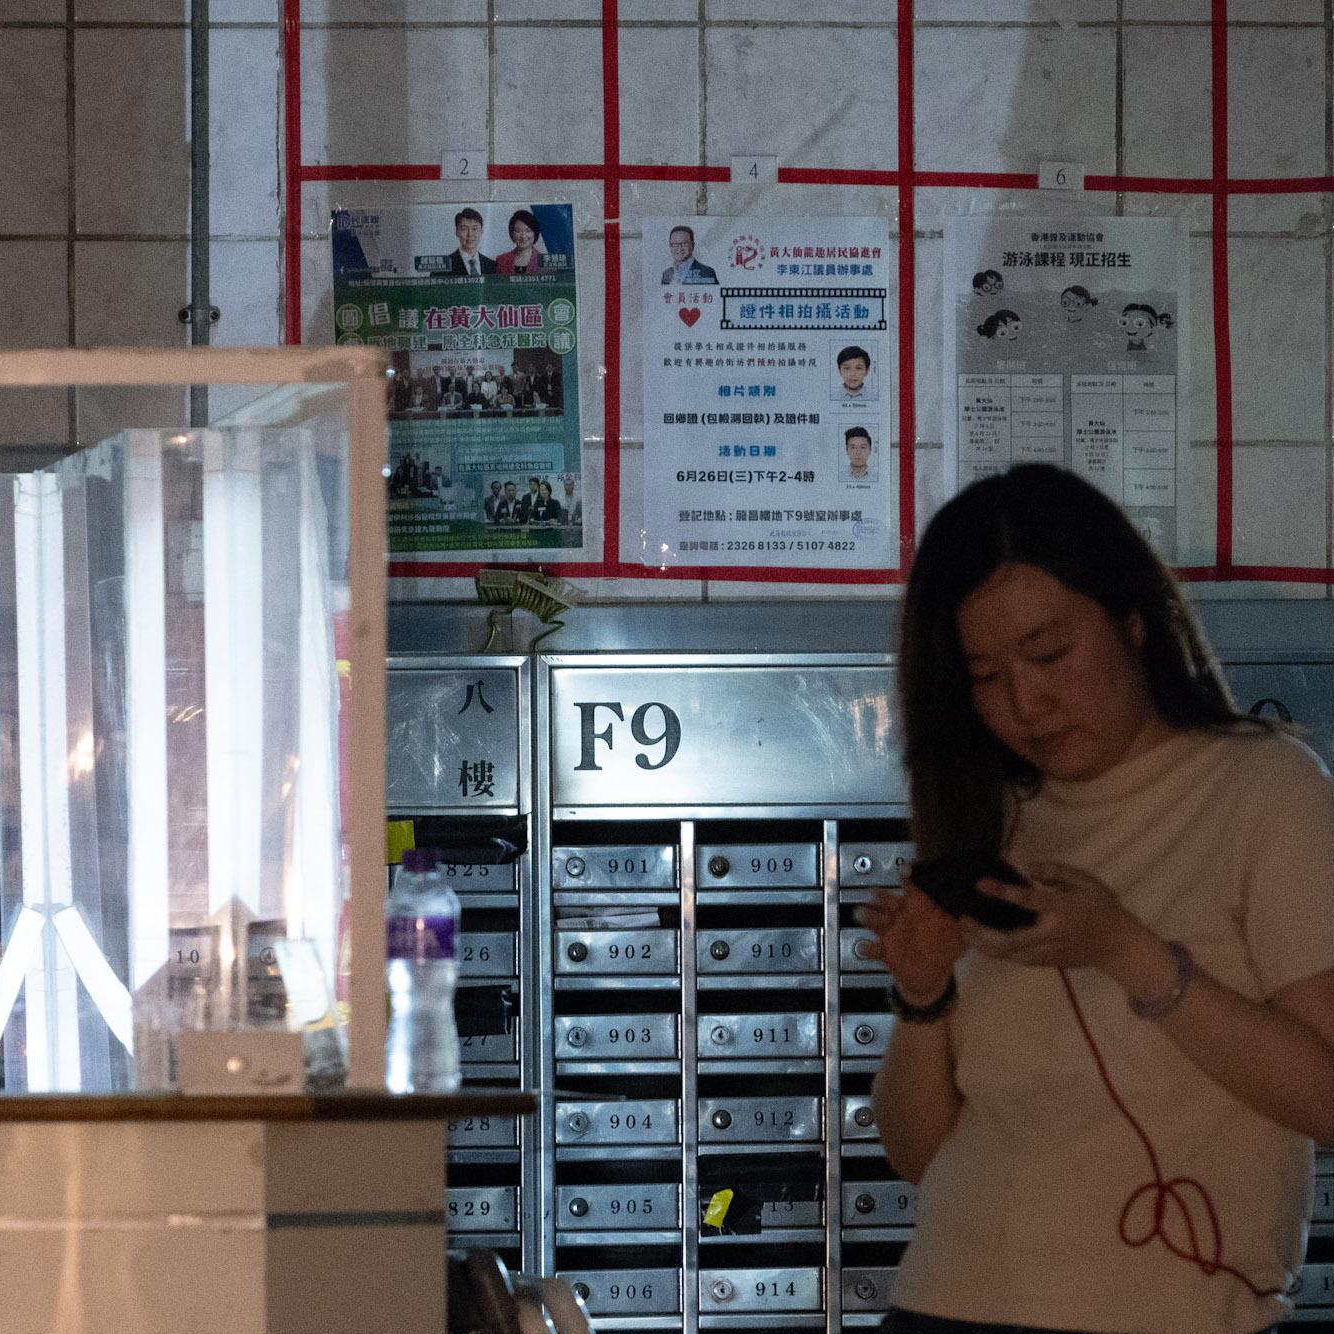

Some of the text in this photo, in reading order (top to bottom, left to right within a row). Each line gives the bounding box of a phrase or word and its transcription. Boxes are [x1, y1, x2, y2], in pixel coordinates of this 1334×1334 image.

[459, 158, 469, 175] 2
[748, 163, 759, 179] 4
[1056, 169, 1066, 185] 6
[1002, 251, 1132, 267] 游泳課程 現正招生
[739, 302, 870, 319] 證件相拍攝活動
[758, 541, 786, 551] 8133
[828, 541, 856, 551] 4822
[457, 679, 495, 798] 八樓
[573, 702, 682, 771] F9
[607, 857, 649, 876] 901
[750, 857, 794, 874] 909
[463, 946, 490, 961] 26
[608, 943, 652, 960] 902
[750, 942, 793, 959] 910
[608, 1027, 652, 1044] 903
[752, 1027, 791, 1044] 911
[608, 1114, 652, 1130] 904
[754, 1111, 794, 1126] 912
[449, 1201, 491, 1216] 829
[609, 1198, 654, 1215] 905
[609, 1283, 653, 1300] 906
[755, 1281, 796, 1297] 914
